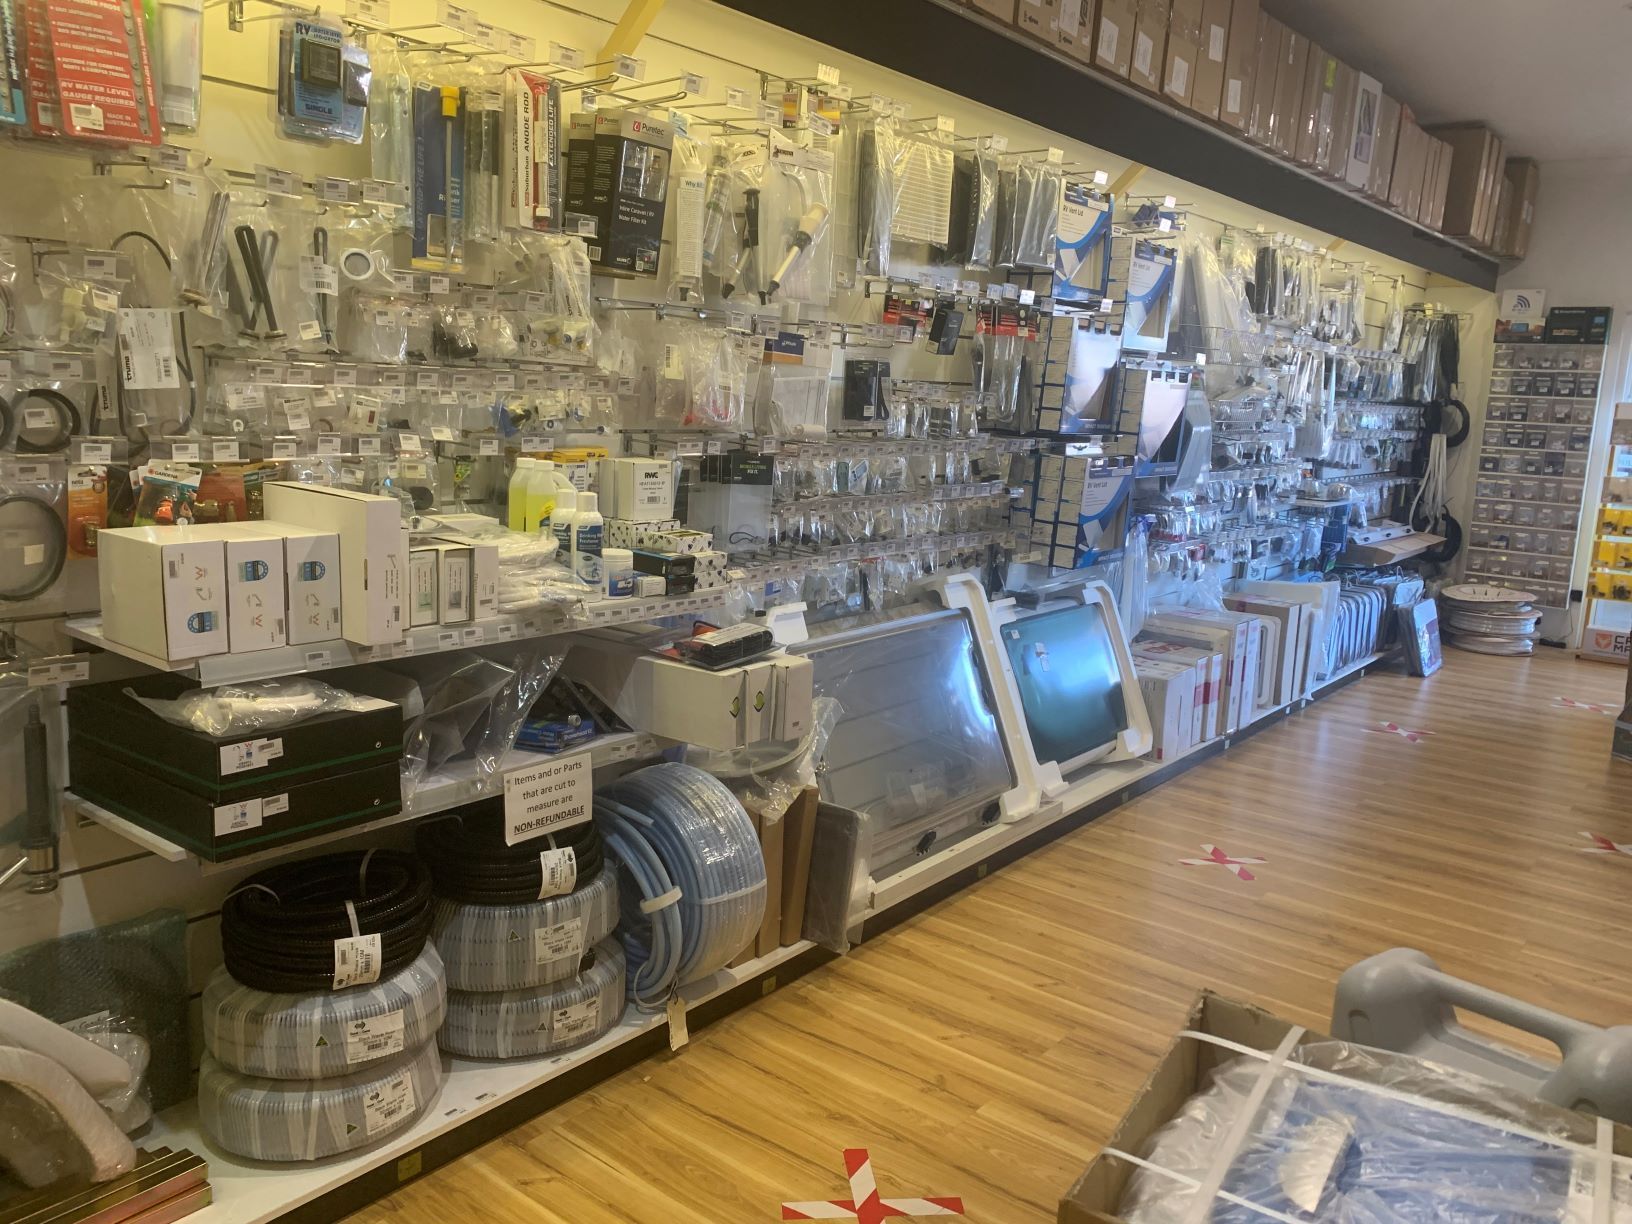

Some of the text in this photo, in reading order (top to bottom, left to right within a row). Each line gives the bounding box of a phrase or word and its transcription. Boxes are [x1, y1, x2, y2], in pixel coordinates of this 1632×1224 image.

[295, 22, 311, 36] RV
[75, 82, 105, 93] WATER
[106, 87, 131, 97] LEVEL
[62, 90, 93, 100] GAUGE
[94, 94, 136, 107] REQUIRED
[305, 103, 333, 115] SINGLE
[547, 98, 555, 118] LIFE
[105, 119, 138, 128] AUSTRALIA
[106, 112, 123, 120] MADE
[641, 123, 665, 136] Puretec
[619, 215, 631, 223] Water
[101, 385, 109, 411] truma
[154, 470, 178, 480] GARDENA
[514, 761, 582, 786] Items and or Parts
[522, 779, 576, 800] that are cut to
[526, 795, 573, 814] measure are
[513, 805, 585, 835] NON-REFUNDABLE
